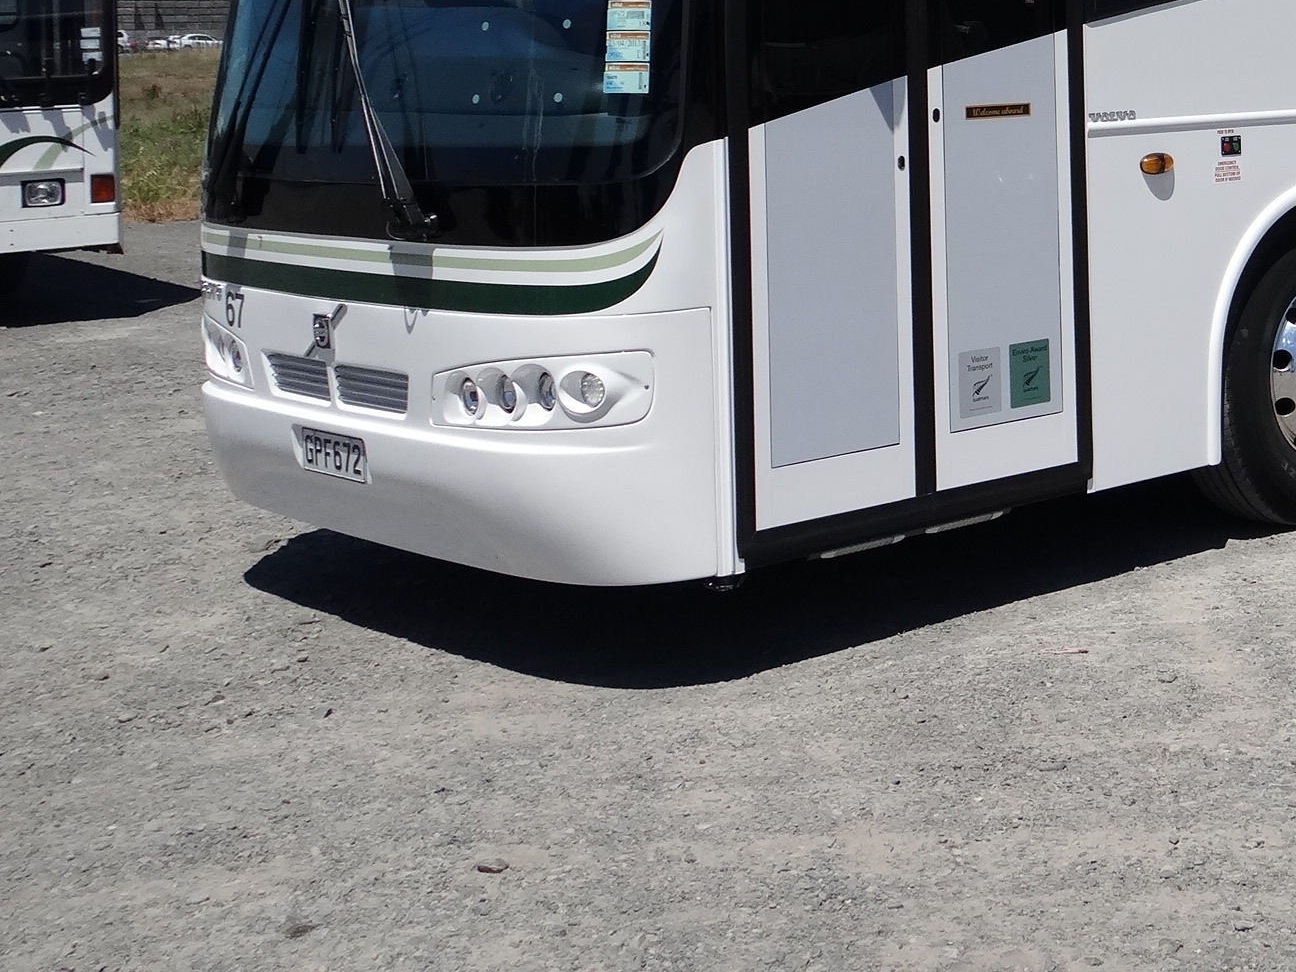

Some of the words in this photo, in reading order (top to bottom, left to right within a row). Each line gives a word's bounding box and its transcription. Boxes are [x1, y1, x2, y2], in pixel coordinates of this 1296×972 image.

[1088, 110, 1136, 123] VOLVO
[225, 291, 244, 328] 67
[971, 355, 988, 363] Visitor
[1022, 355, 1038, 363] Silver
[967, 363, 993, 372] Transport
[304, 434, 362, 476] GPF672
